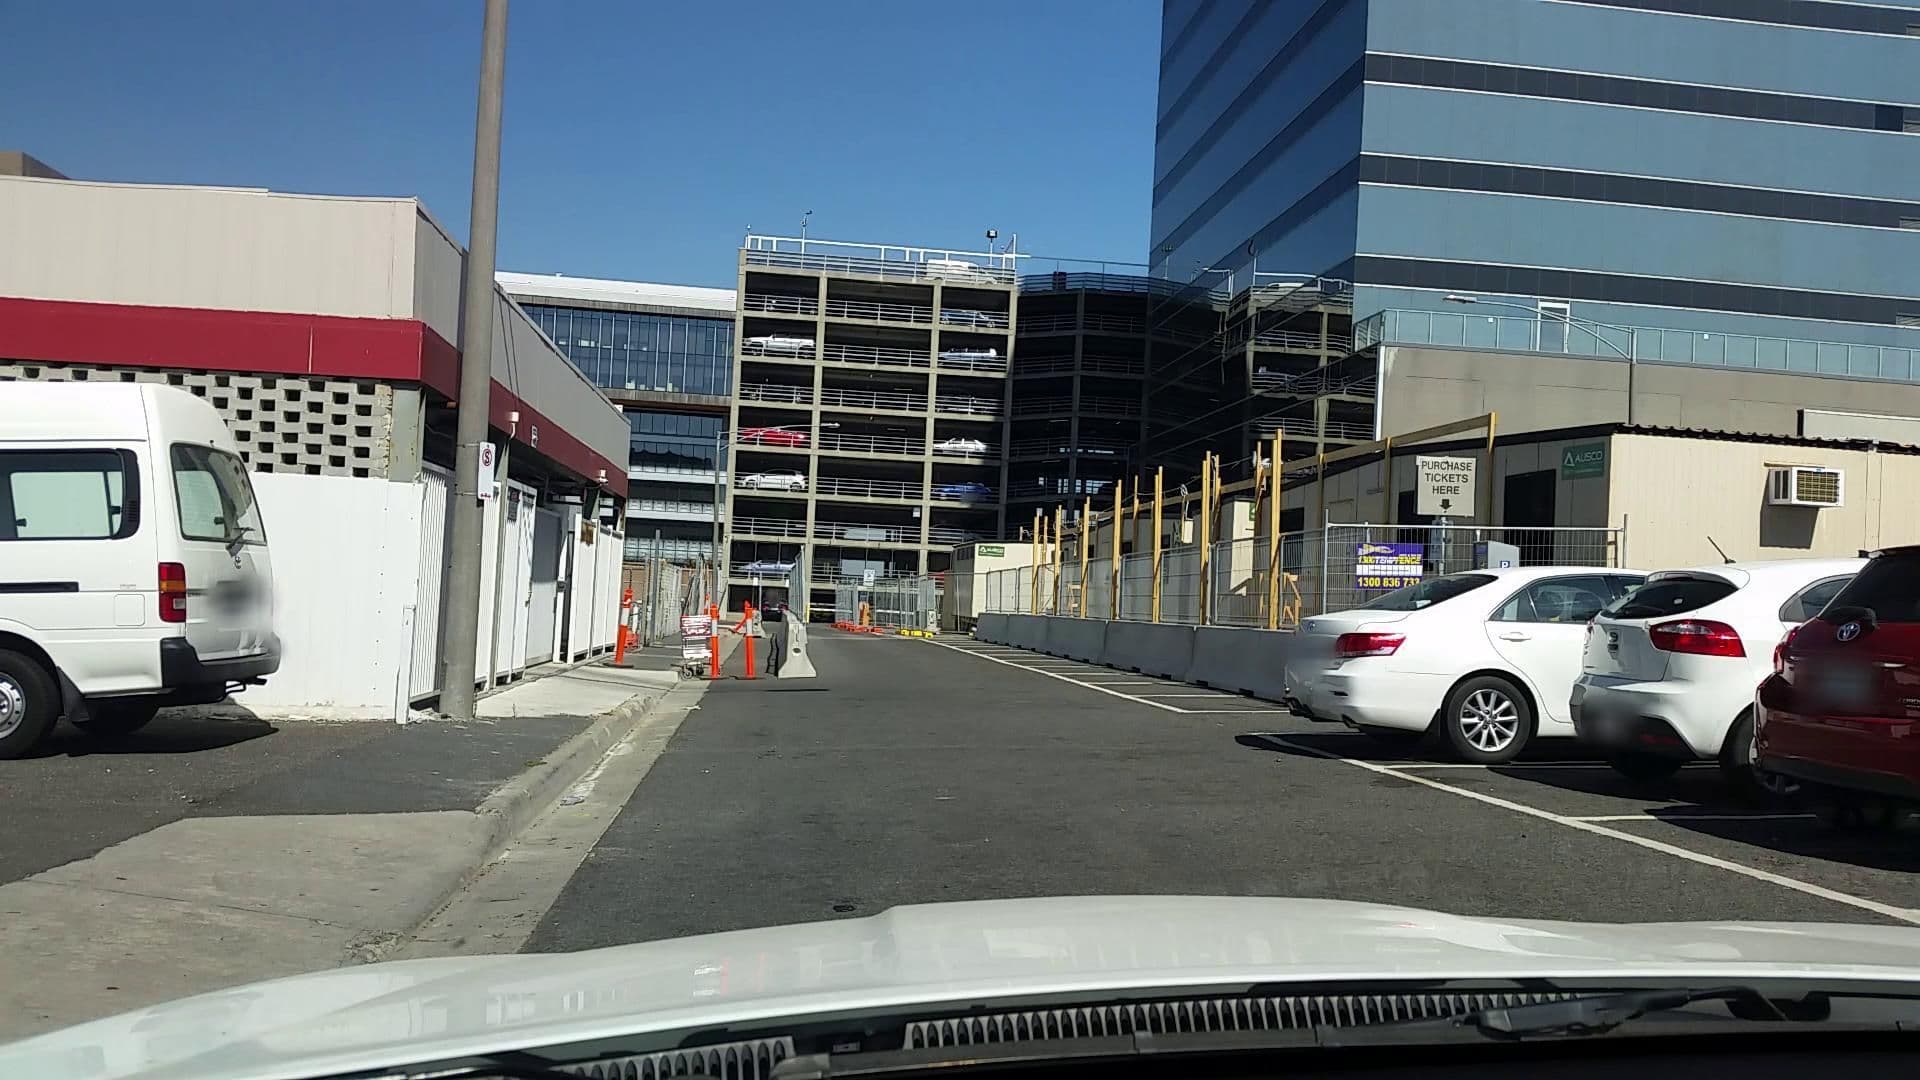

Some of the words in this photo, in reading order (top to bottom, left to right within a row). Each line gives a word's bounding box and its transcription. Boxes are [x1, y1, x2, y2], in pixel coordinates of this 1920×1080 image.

[1421, 460, 1473, 471] PURCHASE
[1424, 472, 1469, 483] TICKETS
[1432, 485, 1461, 495] HERE
[1358, 576, 1380, 588] 1300
[1382, 576, 1401, 588] 836
